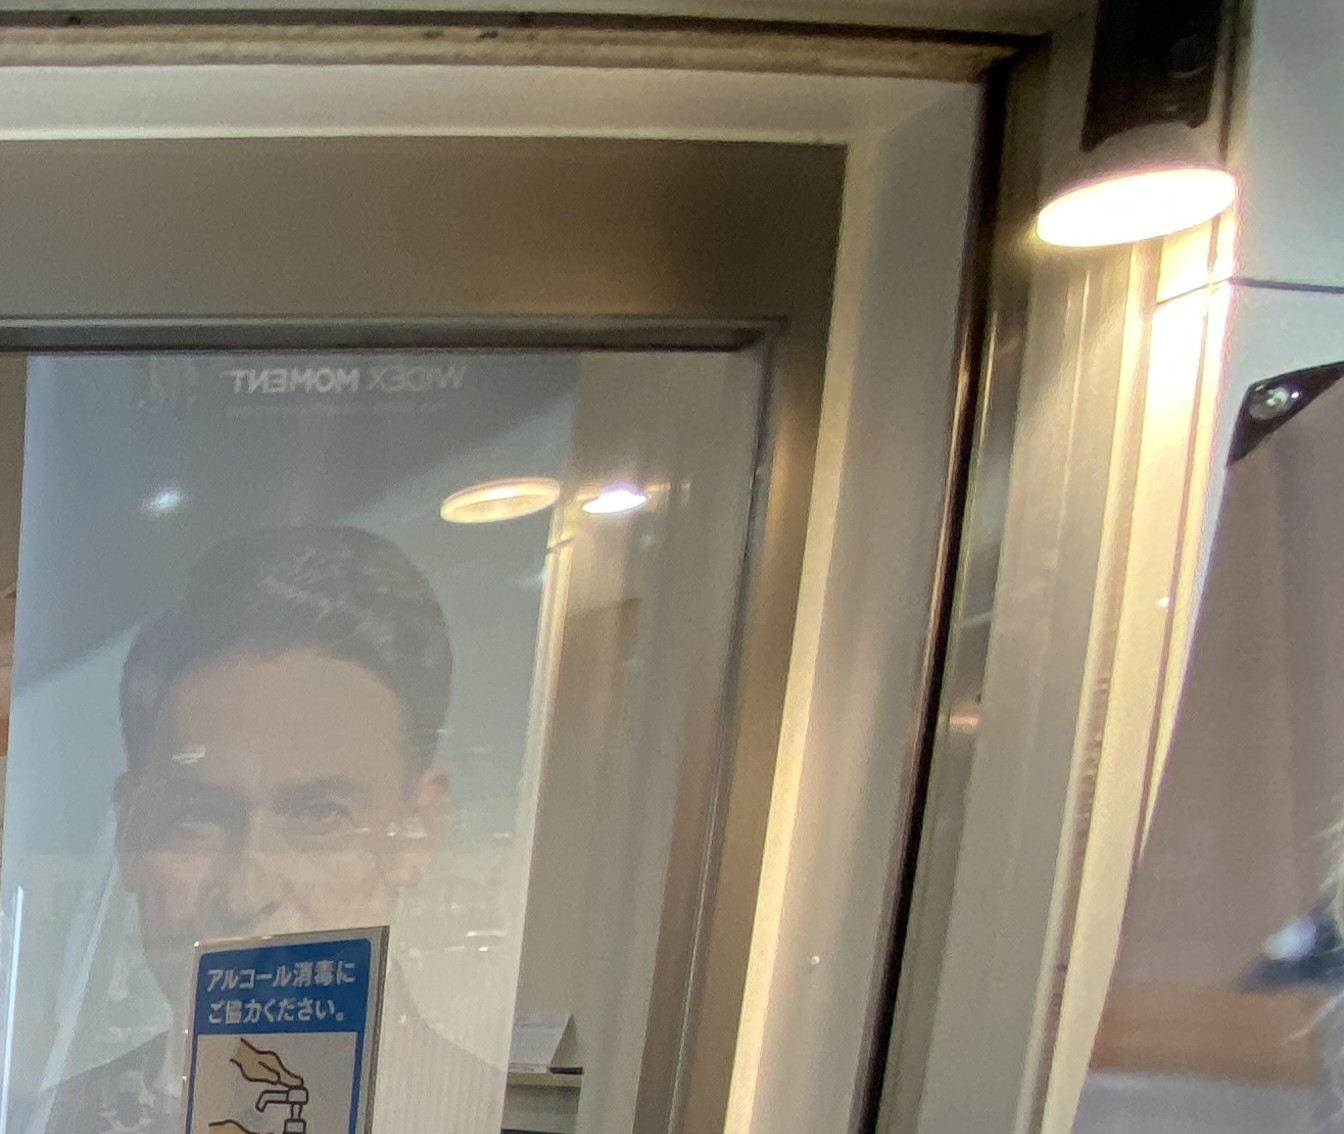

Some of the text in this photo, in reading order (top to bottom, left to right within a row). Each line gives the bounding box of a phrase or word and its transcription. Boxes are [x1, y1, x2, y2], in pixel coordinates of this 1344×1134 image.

[207, 959, 356, 992] アルコール消毒に
[208, 998, 346, 1025] ご協力ください。
